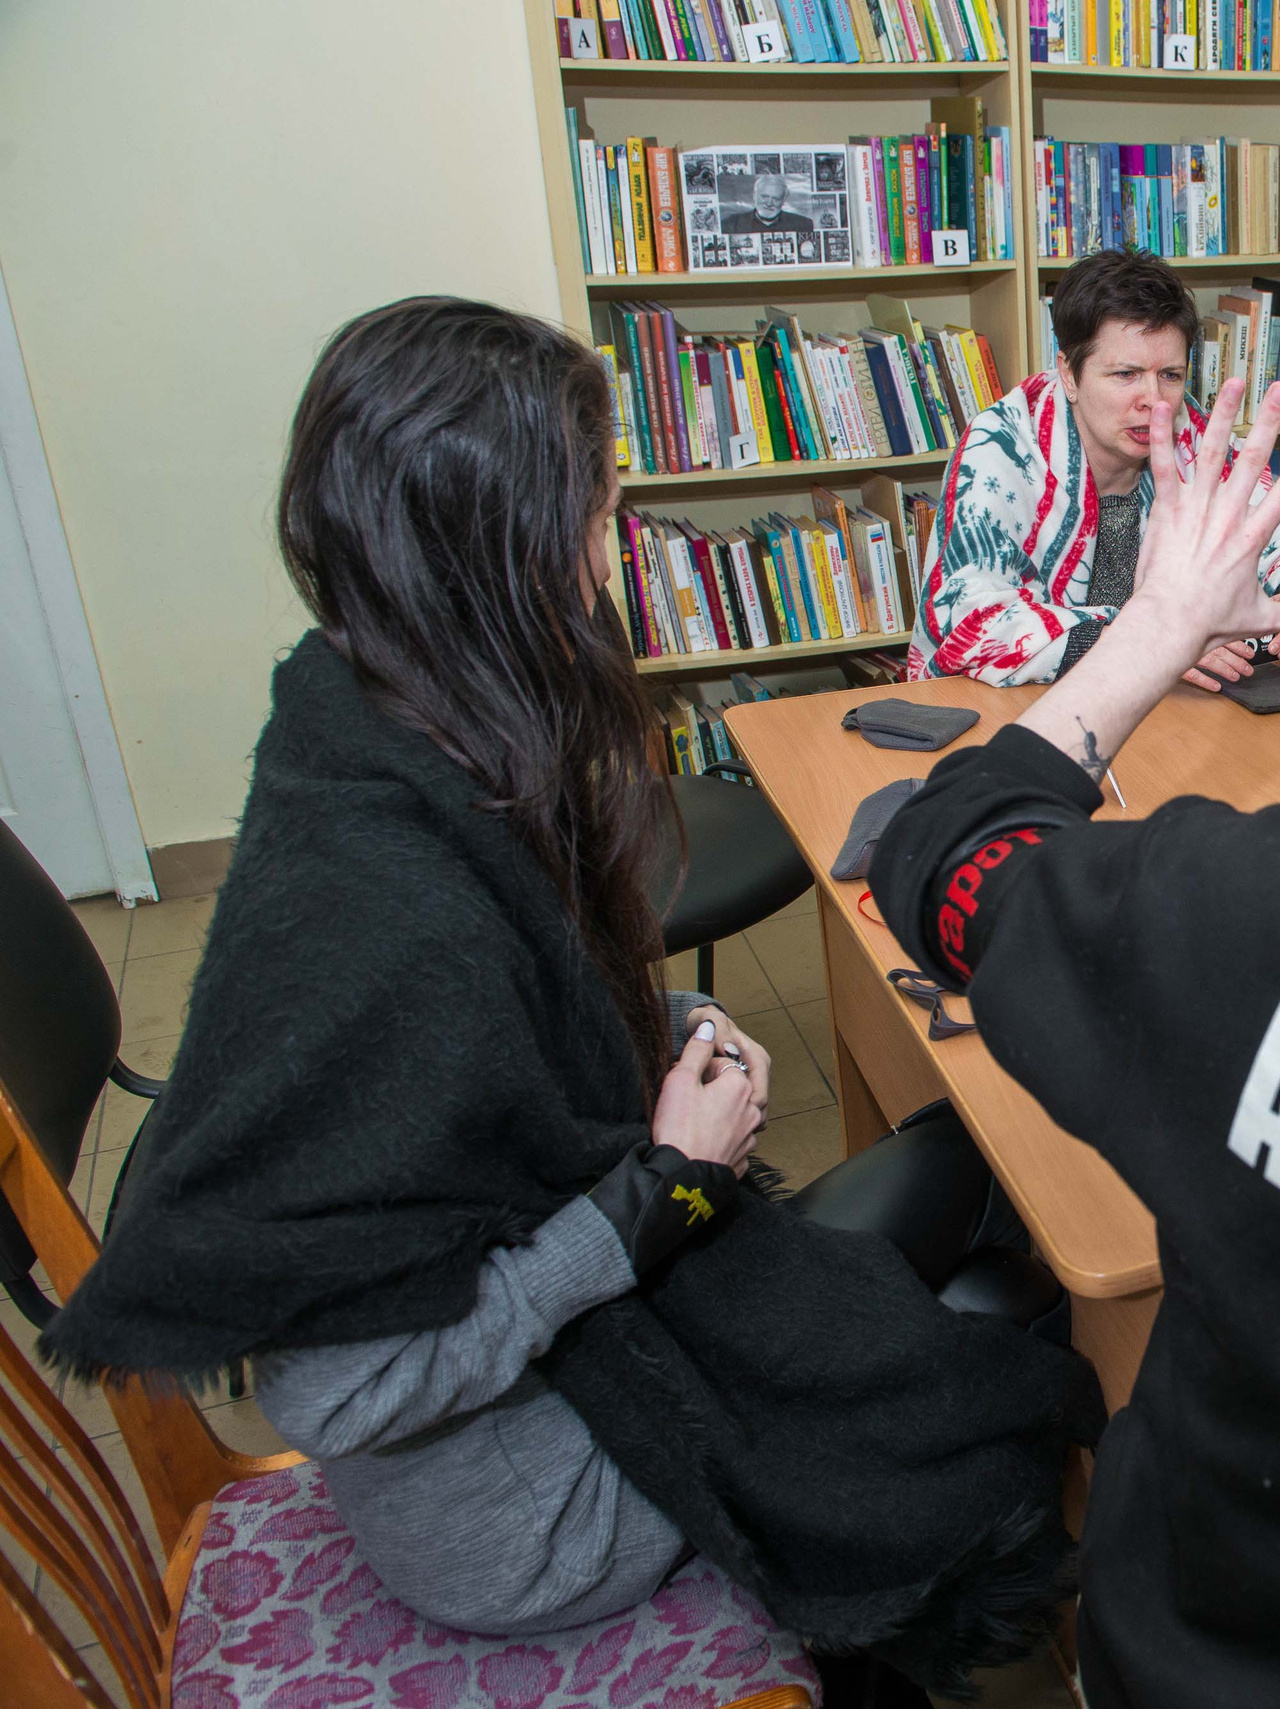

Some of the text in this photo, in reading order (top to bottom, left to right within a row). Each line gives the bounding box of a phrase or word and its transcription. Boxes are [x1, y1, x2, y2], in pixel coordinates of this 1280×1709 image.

[577, 29, 591, 49] А
[755, 33, 774, 55] Б
[1173, 44, 1186, 63] К
[655, 153, 668, 169] КИР
[903, 150, 914, 165] КИР
[657, 171, 671, 207] БУЛЫЧЕВ
[904, 167, 916, 201] БУЛЫЧЕВ
[942, 239, 958, 257] В
[1239, 326, 1247, 360] МИКЕШ
[738, 442, 750, 460] Г
[829, 545, 839, 576] Денискины
[837, 580, 852, 629] ВИКТОР ДРАГУНСКИЙ
[882, 586, 895, 622] Драгунский
